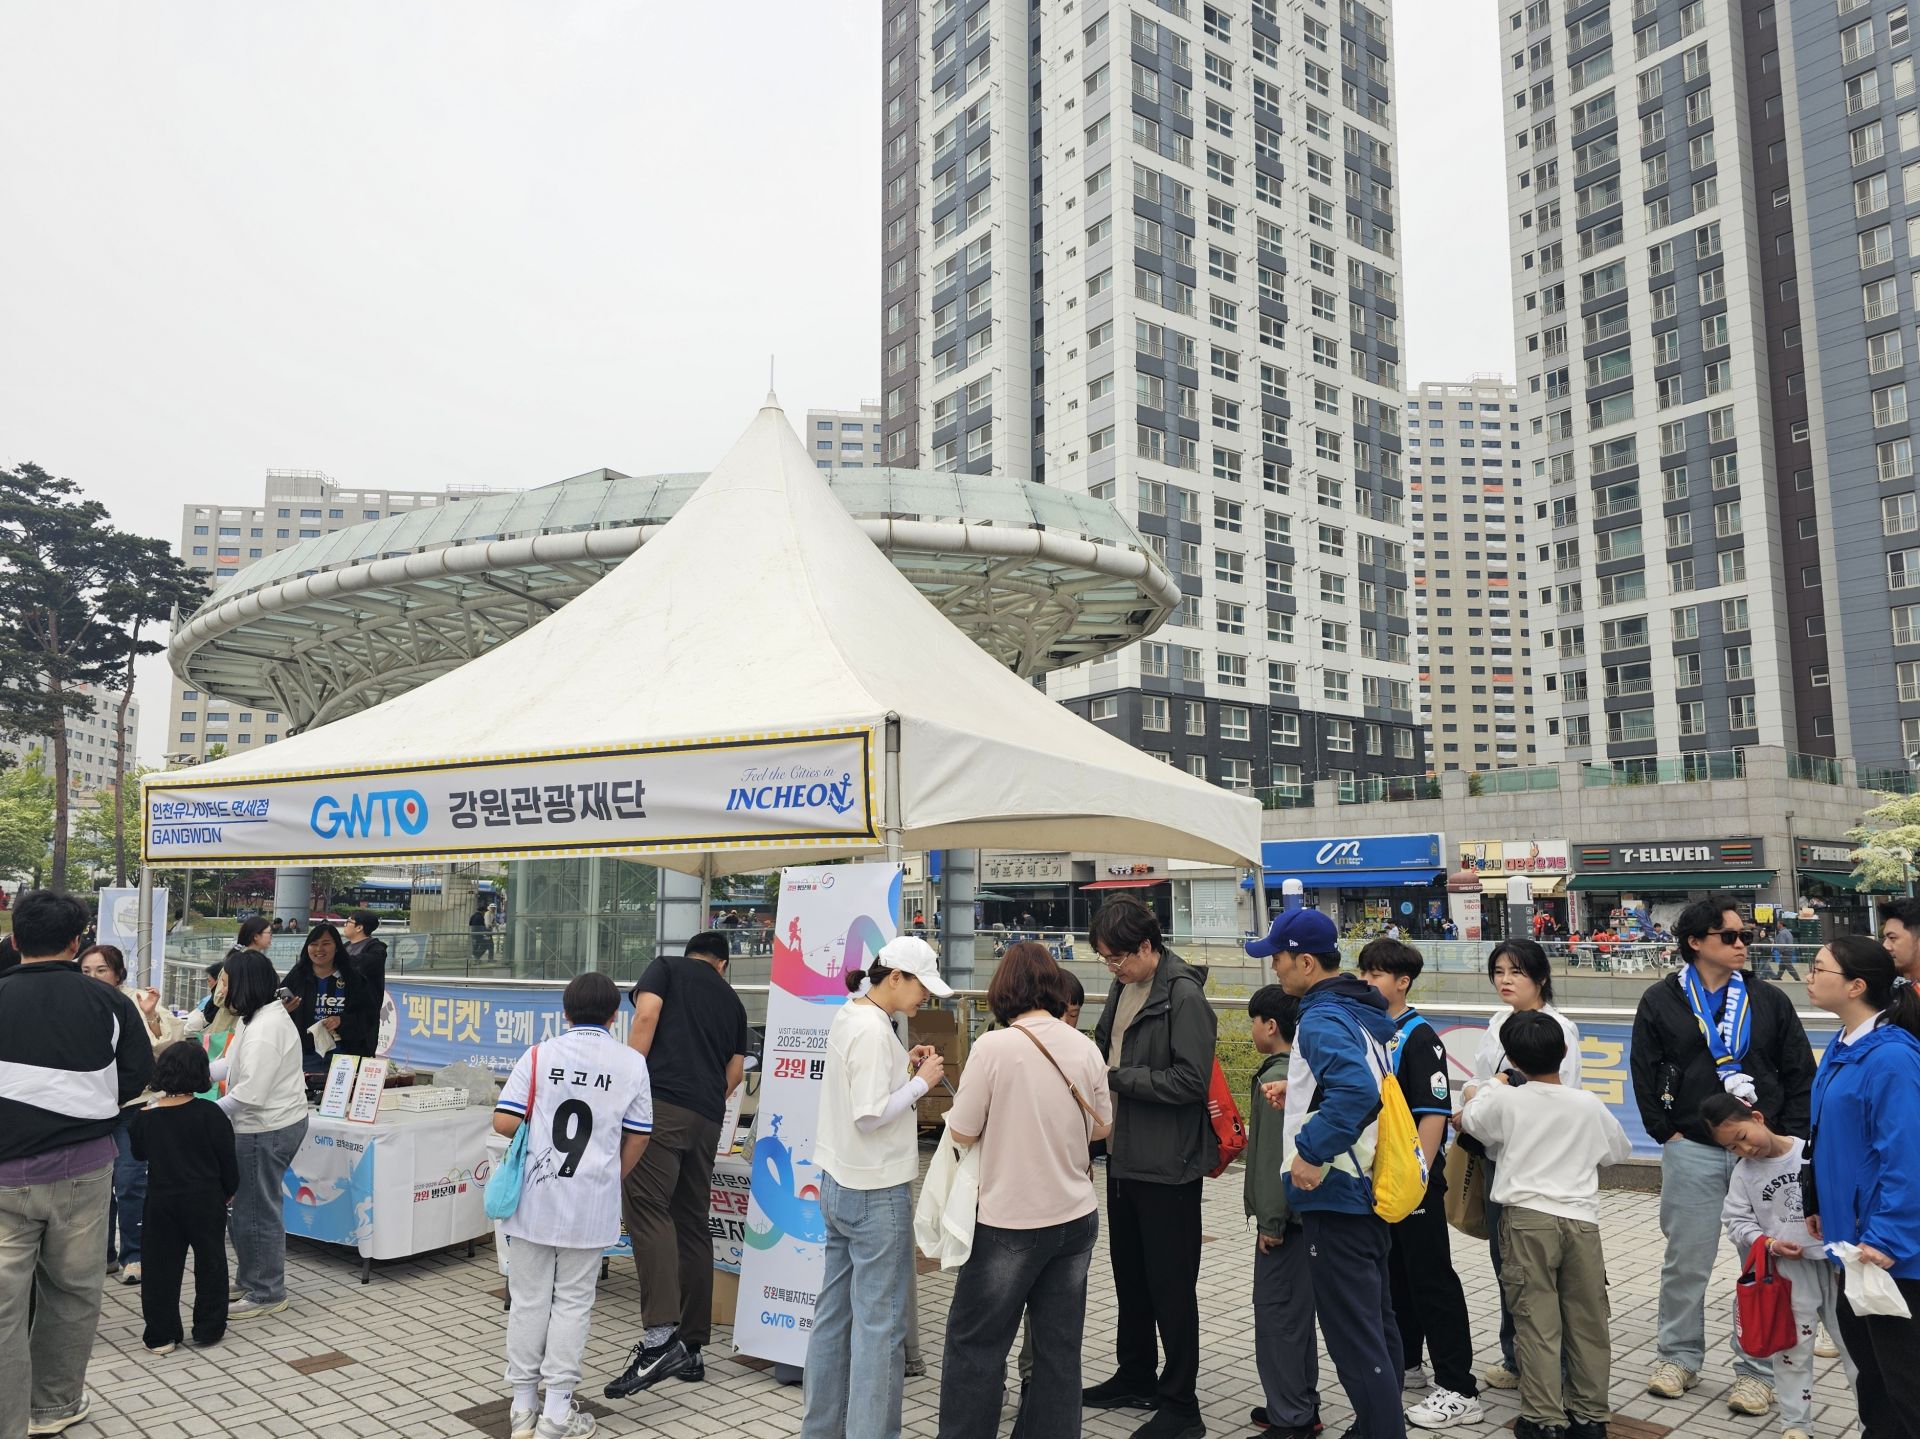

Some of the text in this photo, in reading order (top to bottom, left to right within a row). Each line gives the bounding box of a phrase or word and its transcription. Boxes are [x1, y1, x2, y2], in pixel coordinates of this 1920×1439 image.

[741, 765, 835, 783] Feel the Cities in
[449, 779, 646, 829] 강원관광재단
[725, 779, 850, 812] INCHEON
[152, 798, 269, 820] 인천유나이티드 면세점
[310, 789, 429, 840] GWTO
[152, 827, 222, 845] GANGWON
[315, 993, 346, 1007] ifez
[494, 1009, 534, 1045] 함께
[778, 1027, 791, 1035] VISIT
[792, 1028, 817, 1036] GANGWON
[548, 1067, 612, 1091] 무고사
[773, 1057, 806, 1079] 강원
[552, 1098, 593, 1178] 9
[414, 1189, 430, 1203] 강원
[431, 1185, 456, 1199] 방문의
[763, 1285, 817, 1306] 강원특별자치도
[761, 1311, 796, 1329] GWTO
